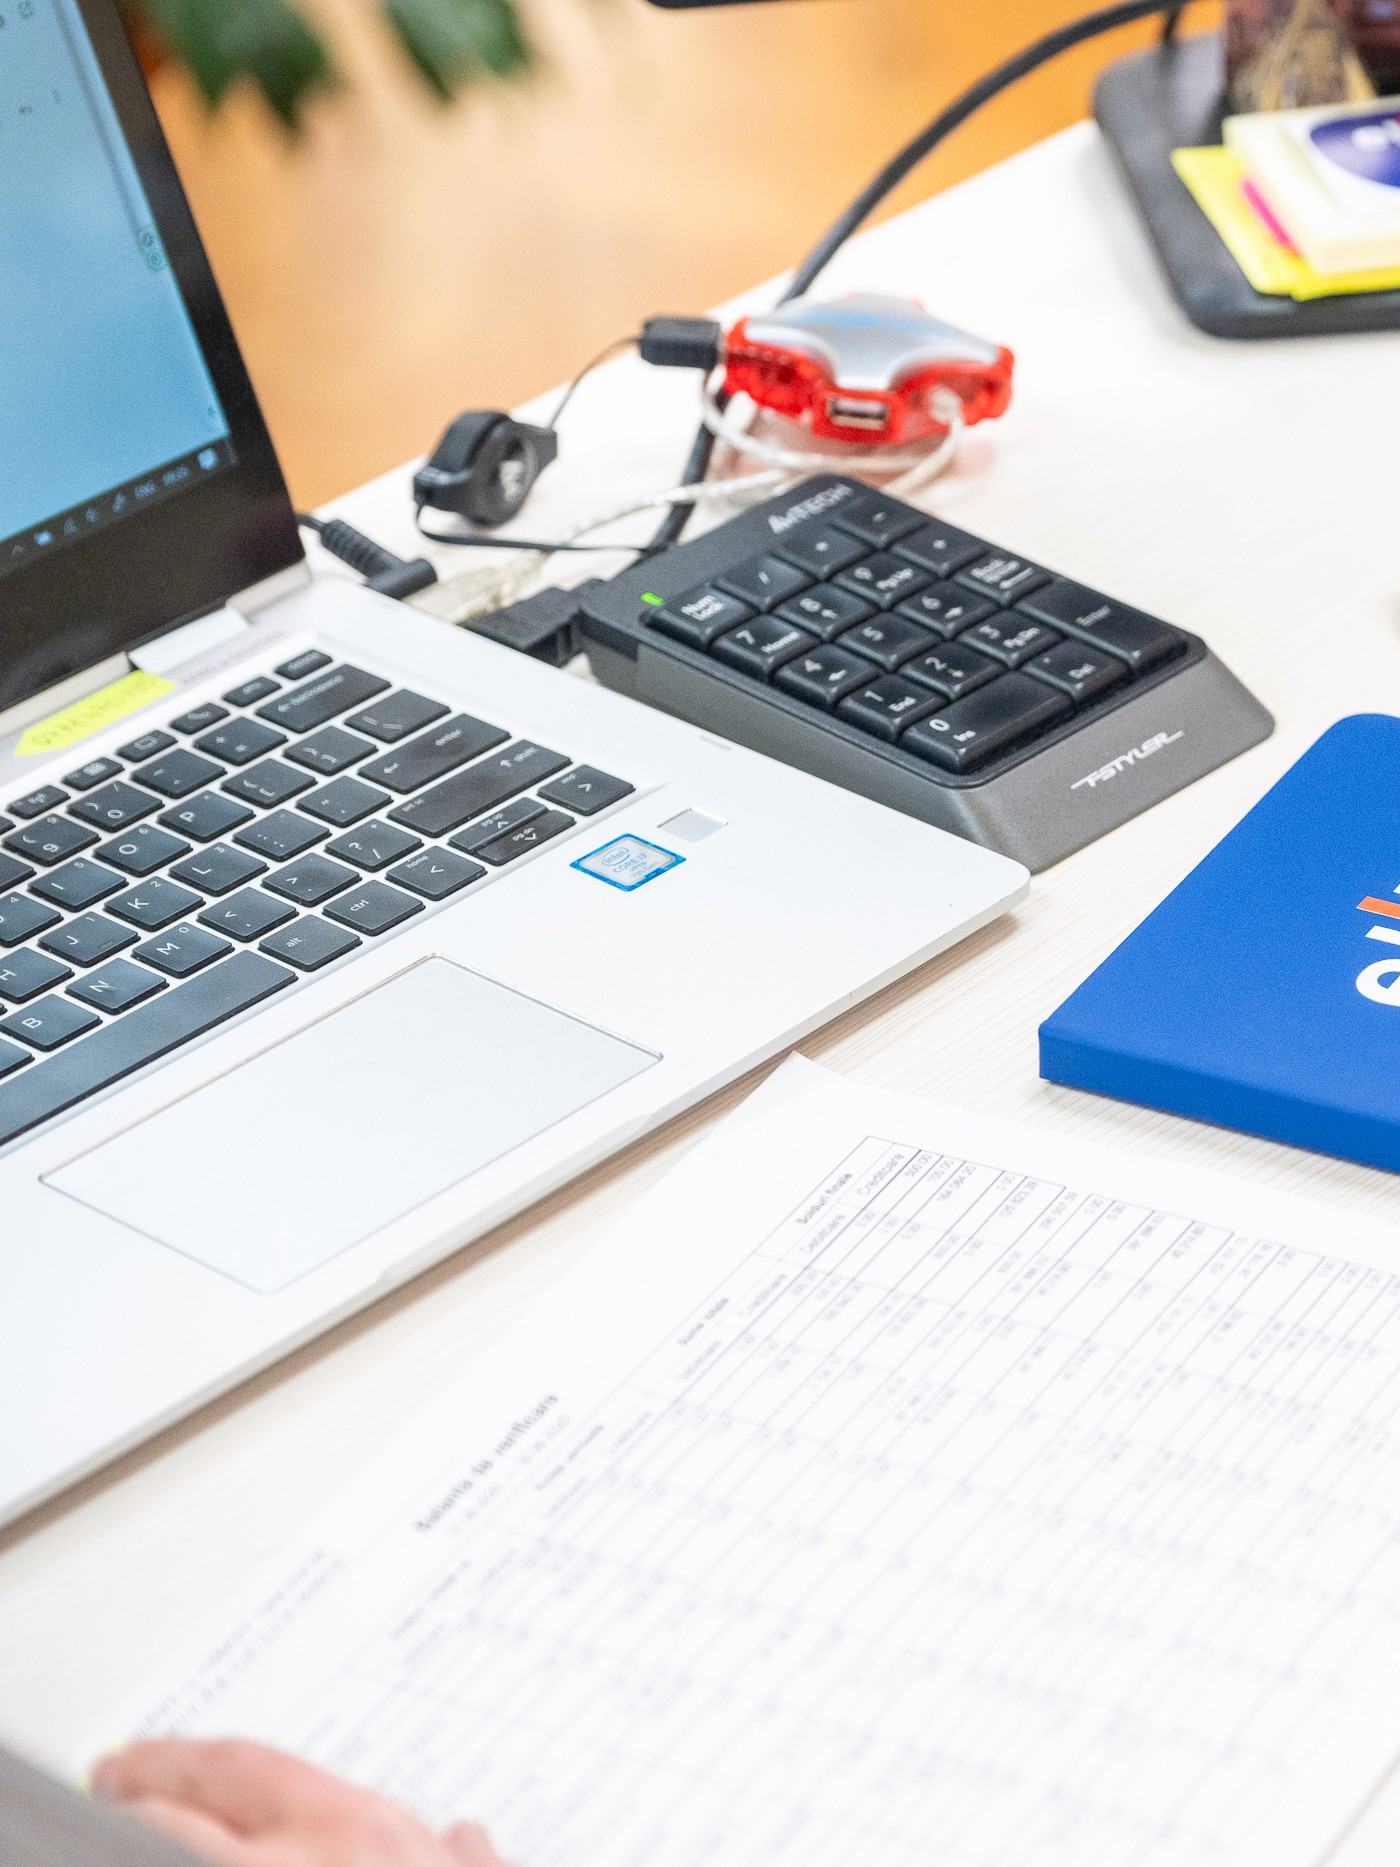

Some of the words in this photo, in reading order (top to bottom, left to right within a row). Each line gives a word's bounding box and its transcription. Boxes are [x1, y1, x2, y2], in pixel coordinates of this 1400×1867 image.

[736, 629, 755, 645] 7
[862, 626, 884, 641] 5
[761, 631, 800, 653] Home
[925, 657, 947, 671] 2
[864, 690, 884, 702] 1
[929, 719, 950, 732] 0
[435, 729, 462, 747] enter
[514, 747, 537, 762] shift
[107, 809, 123, 819] 0
[179, 811, 195, 823] P
[42, 843, 58, 853] 9
[405, 854, 429, 869] home
[613, 857, 638, 874] CORE
[192, 865, 211, 876] L
[127, 898, 149, 909] K
[350, 898, 369, 912] ctrl
[66, 935, 79, 945] J
[286, 936, 302, 948] alt
[156, 942, 180, 955] M
[89, 980, 111, 993] N
[21, 1017, 42, 1029] B
